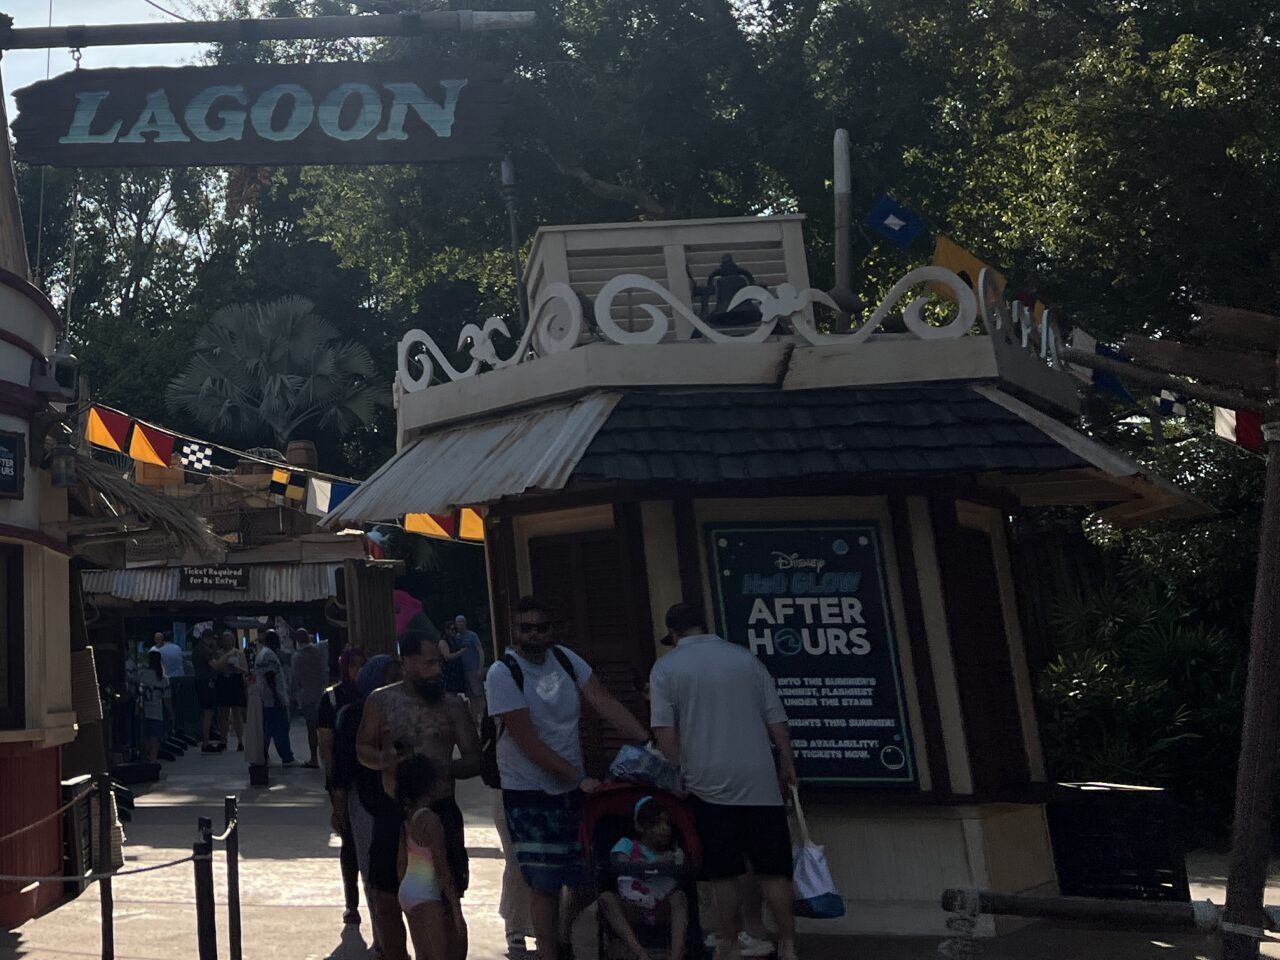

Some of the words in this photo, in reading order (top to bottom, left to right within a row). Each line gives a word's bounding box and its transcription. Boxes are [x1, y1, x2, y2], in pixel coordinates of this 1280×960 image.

[58, 77, 470, 144] LAGOON
[770, 551, 826, 573] Disney
[184, 567, 207, 575] Ticket
[208, 568, 243, 577] Required
[189, 576, 202, 584] for
[791, 571, 863, 593] GLOW
[747, 597, 866, 624] AFTER
[747, 627, 872, 656] HOURS
[784, 698, 818, 706] UNDER
[819, 698, 839, 706] THE
[824, 719, 847, 727] THIS
[801, 750, 842, 758] TICKETS
